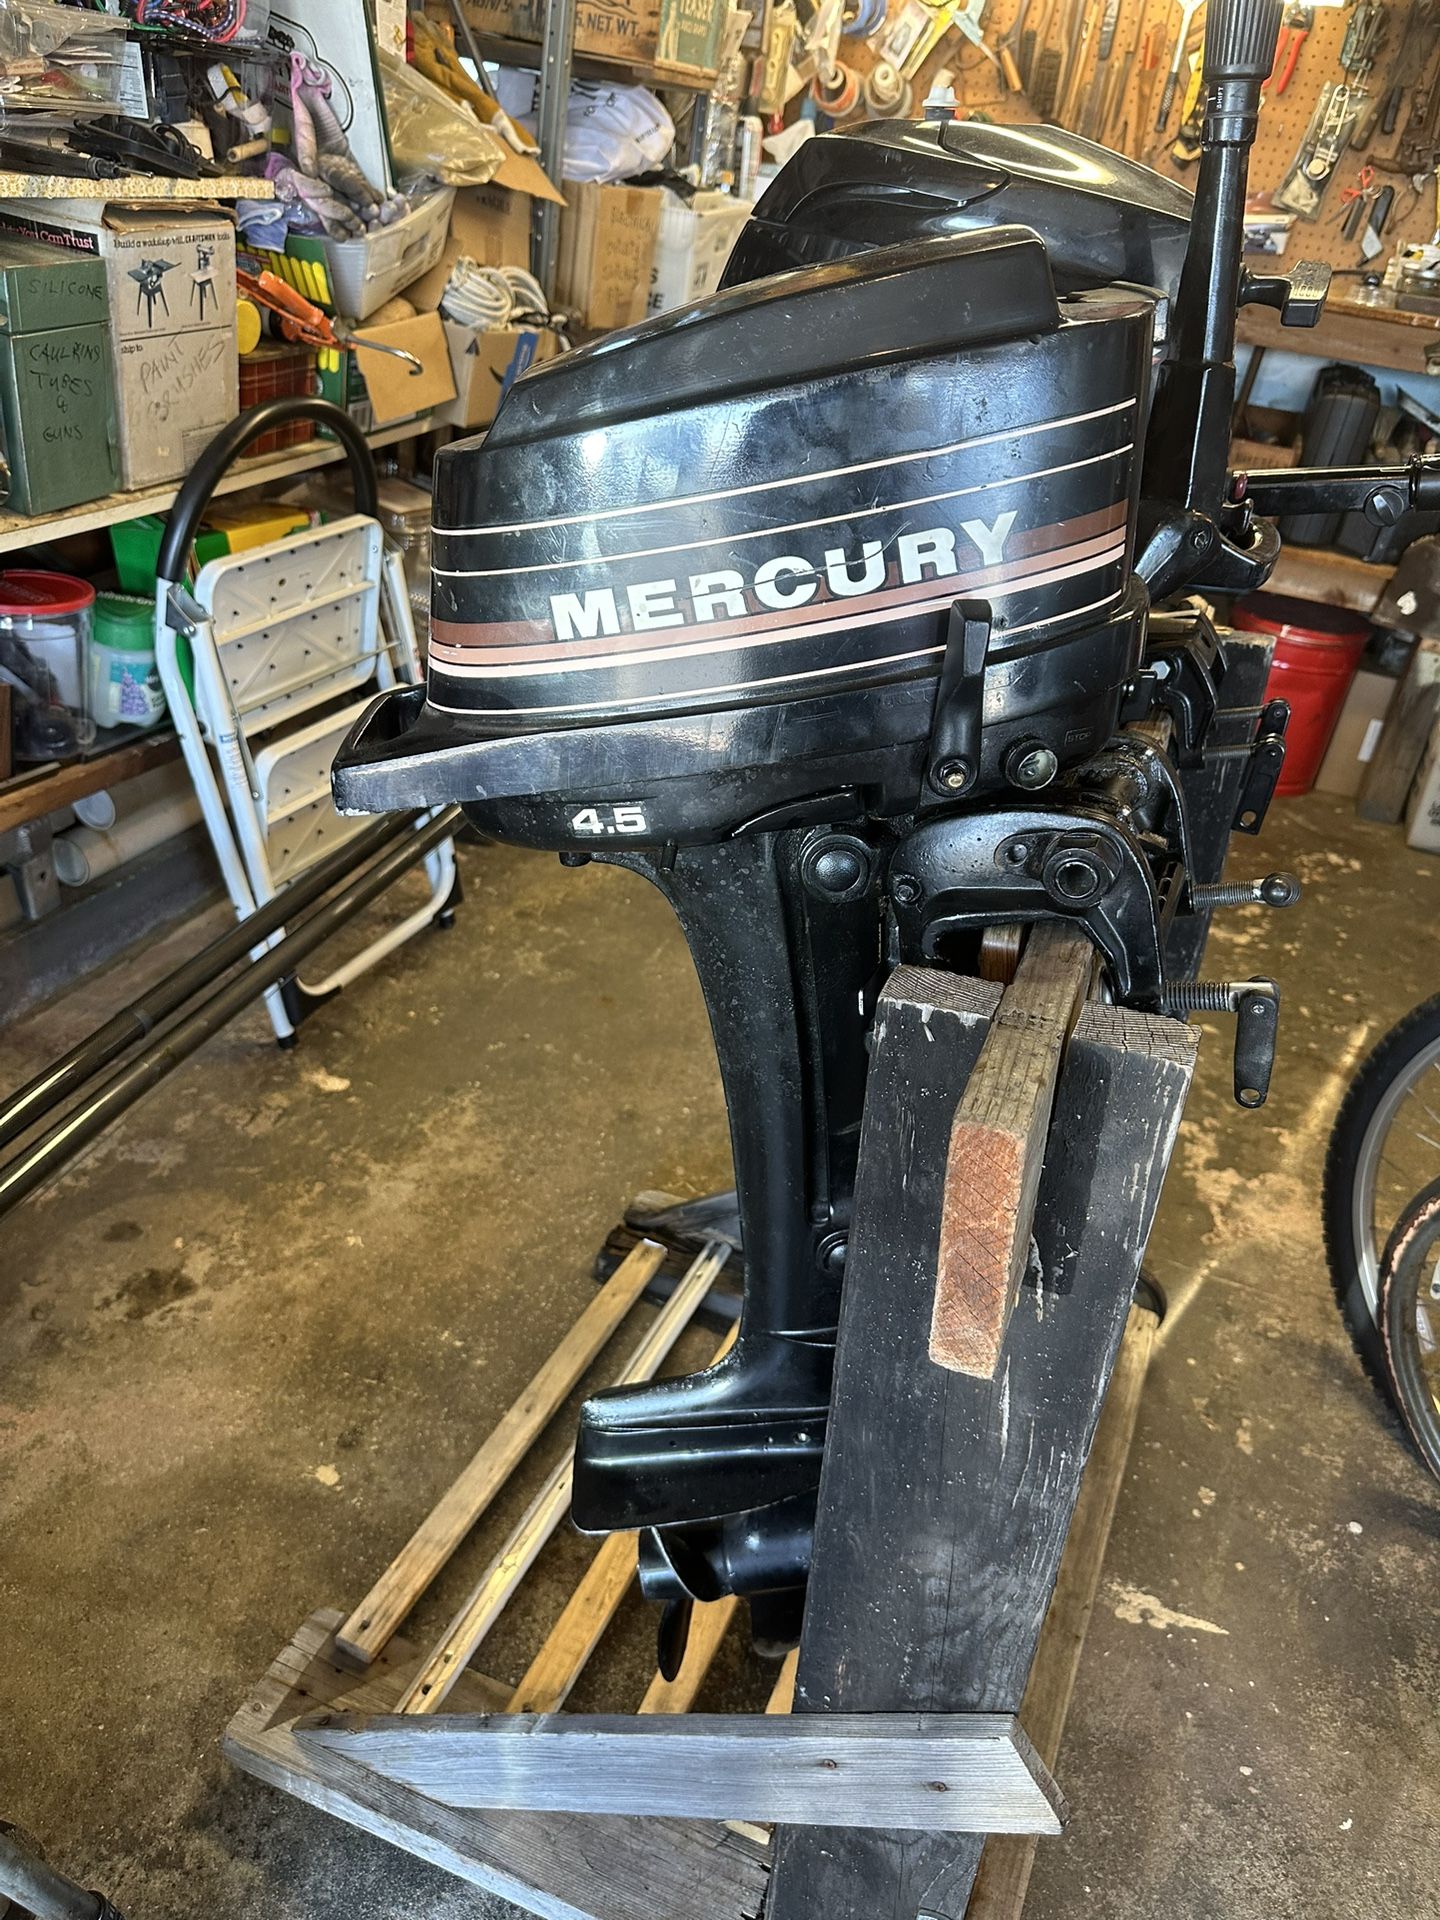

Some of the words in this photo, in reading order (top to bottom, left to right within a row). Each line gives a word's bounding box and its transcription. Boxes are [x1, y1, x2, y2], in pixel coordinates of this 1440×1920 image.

[587, 13, 613, 33] NET
[63, 229, 95, 249] Trust
[28, 279, 103, 300] SILICONE
[29, 370, 93, 397] TUBES
[43, 425, 83, 443] GUNS
[549, 511, 1018, 641] MERCURY
[571, 806, 647, 834] 4.5
